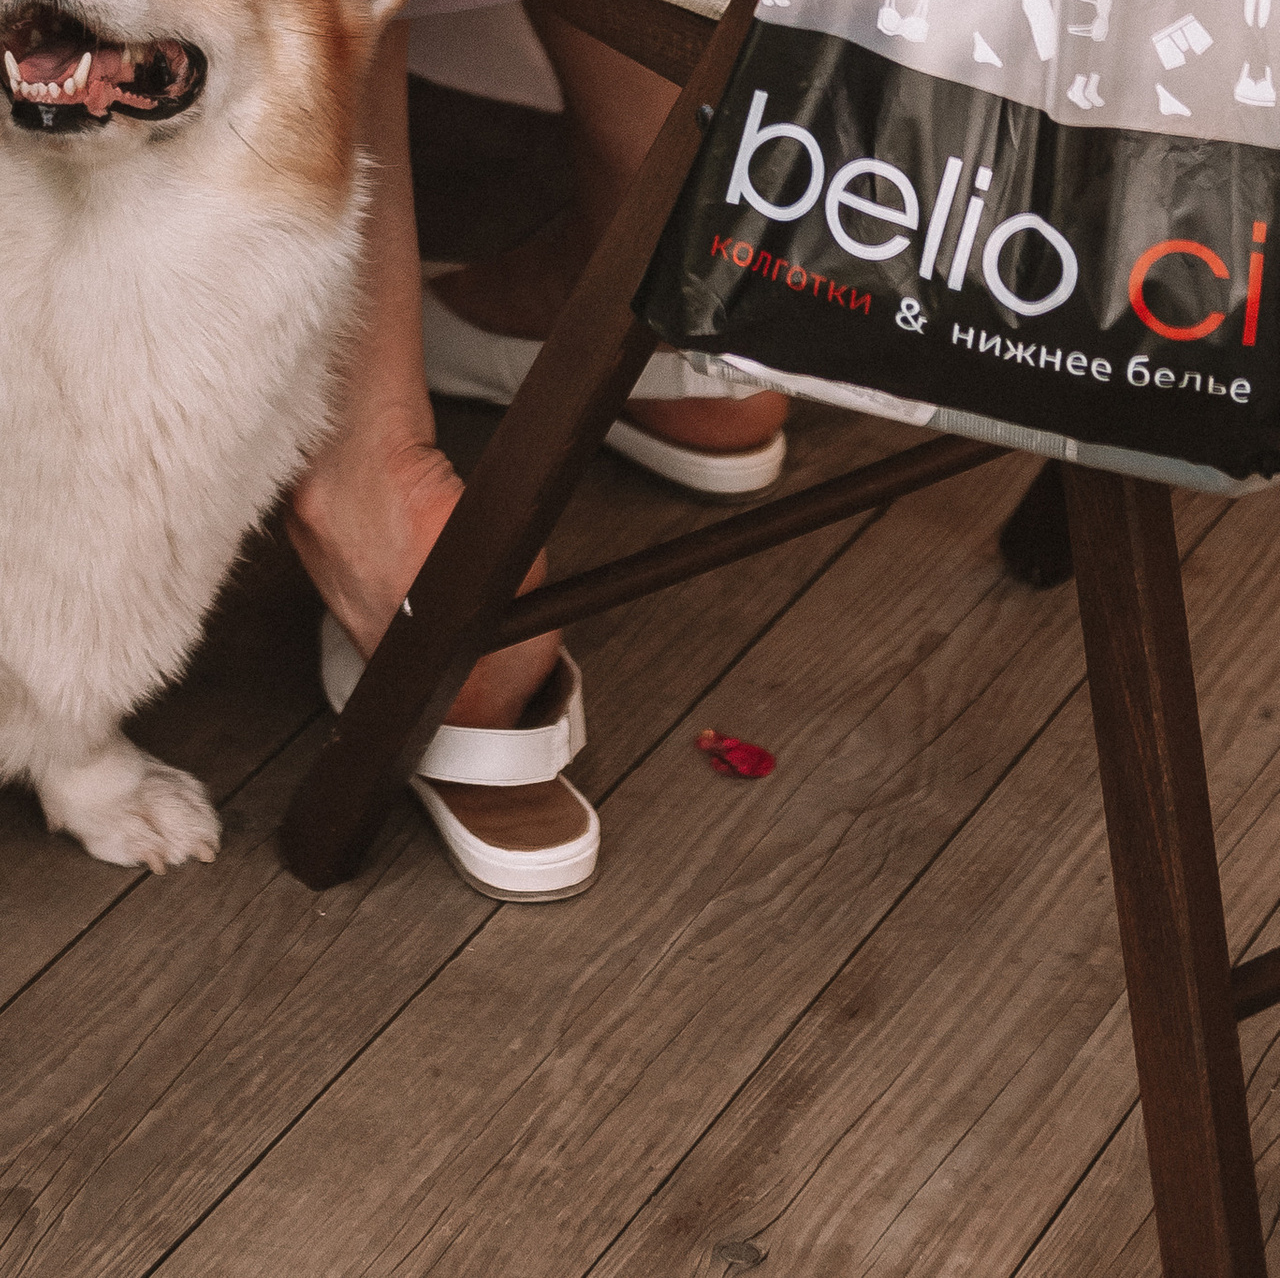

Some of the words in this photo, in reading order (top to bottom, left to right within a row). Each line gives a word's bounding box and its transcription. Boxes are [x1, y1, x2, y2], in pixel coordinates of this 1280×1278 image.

[711, 234, 873, 315] колготки
[895, 296, 926, 335] &
[952, 321, 1112, 382] нижнее
[1127, 354, 1252, 404] белье
[726, 90, 1078, 316] belio
[1128, 221, 1267, 346] ci
